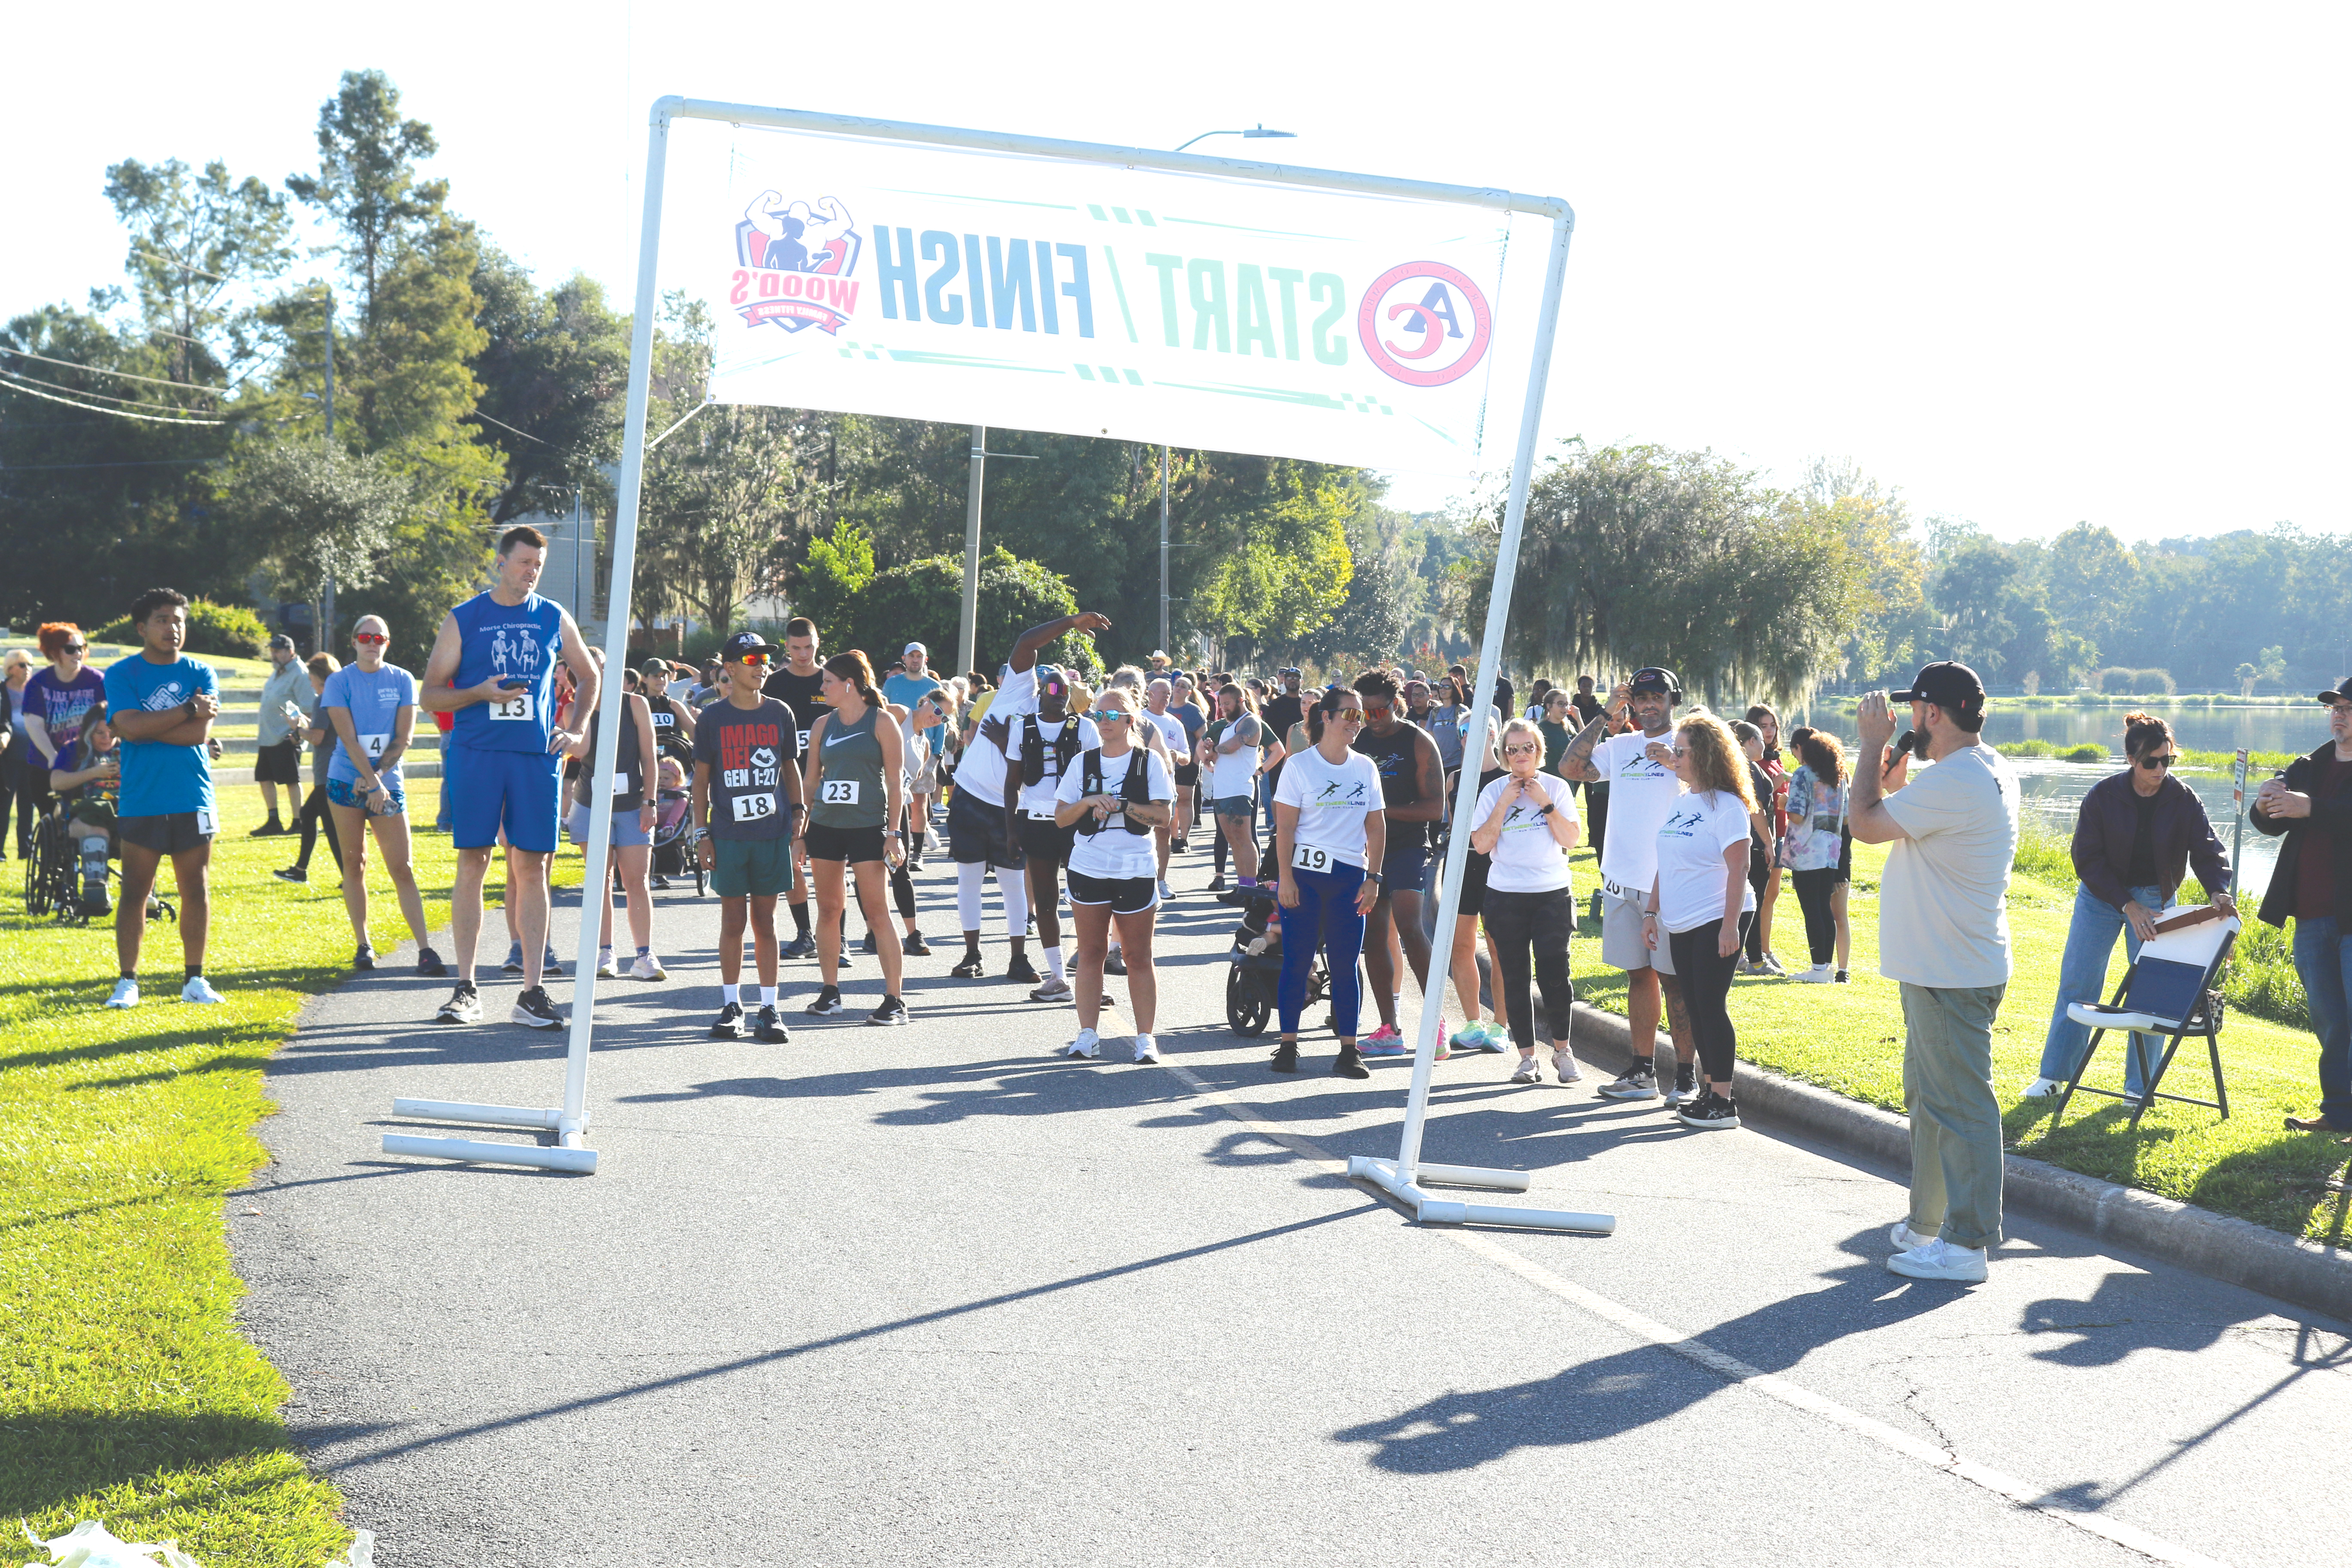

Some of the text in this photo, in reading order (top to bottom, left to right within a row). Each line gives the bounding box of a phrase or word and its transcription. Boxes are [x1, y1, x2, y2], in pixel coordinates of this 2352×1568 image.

[498, 697, 525, 717] 13
[655, 715, 670, 724] 10
[720, 724, 779, 747] IMAGO
[799, 732, 808, 747] 5
[371, 737, 381, 753] 4
[722, 747, 750, 770] DEI
[724, 768, 775, 787] GEN 1:27
[828, 783, 851, 800] 23
[741, 796, 769, 818] 18
[1130, 857, 1152, 869] 17
[1299, 848, 1326, 869] 19
[1606, 879, 1620, 895] 20
